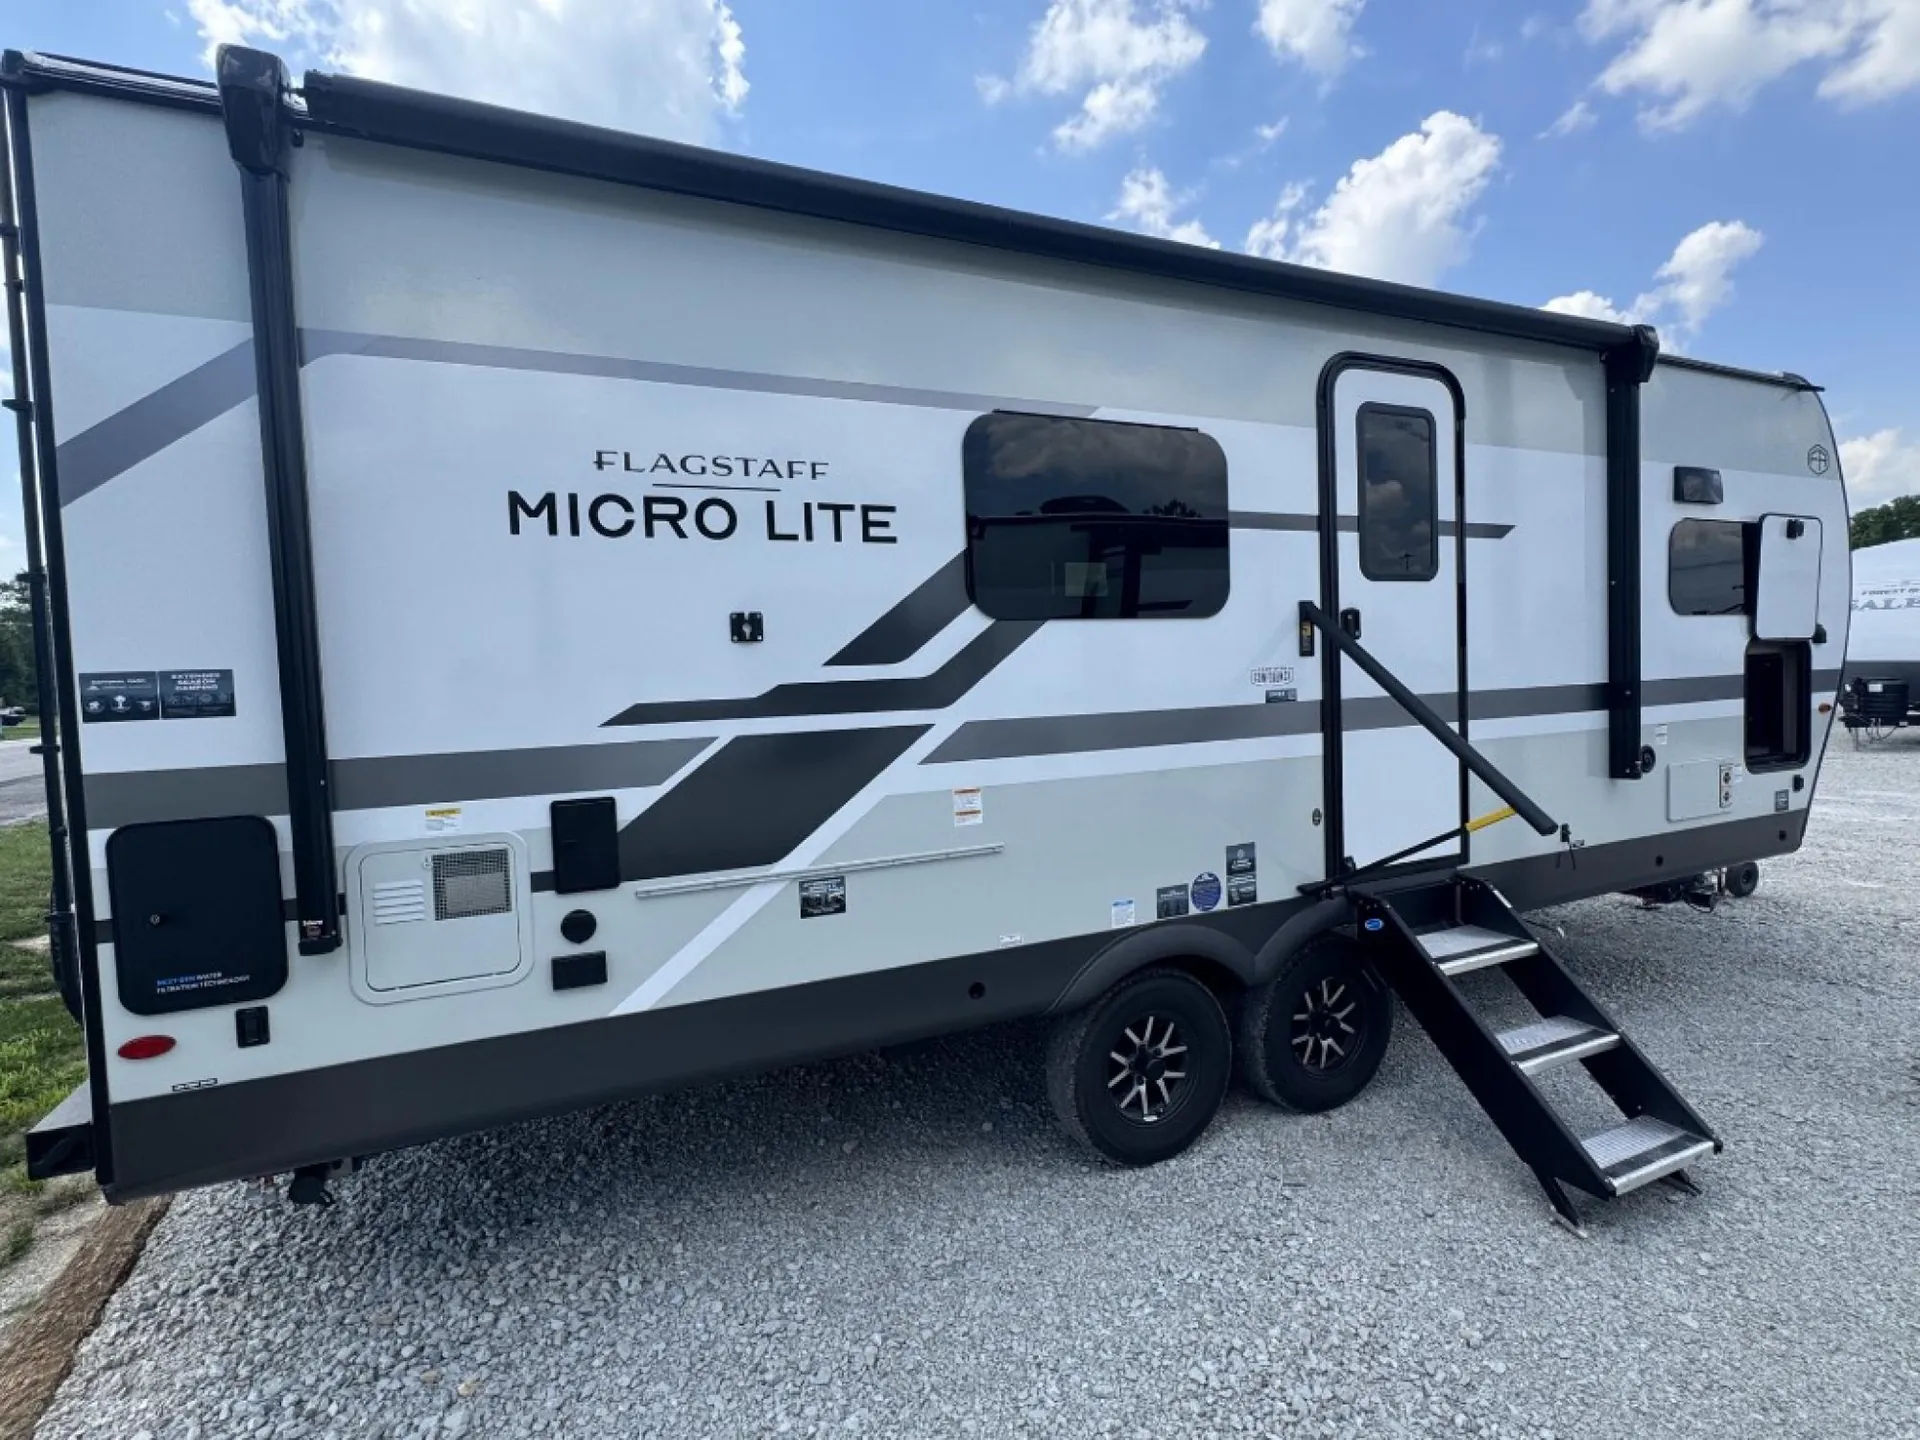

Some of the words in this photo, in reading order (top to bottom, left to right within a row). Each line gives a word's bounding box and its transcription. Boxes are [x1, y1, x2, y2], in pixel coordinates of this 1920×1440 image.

[593, 449, 830, 481] FLAGSTAFF
[507, 490, 738, 541] MICRO
[766, 500, 898, 544] LITE
